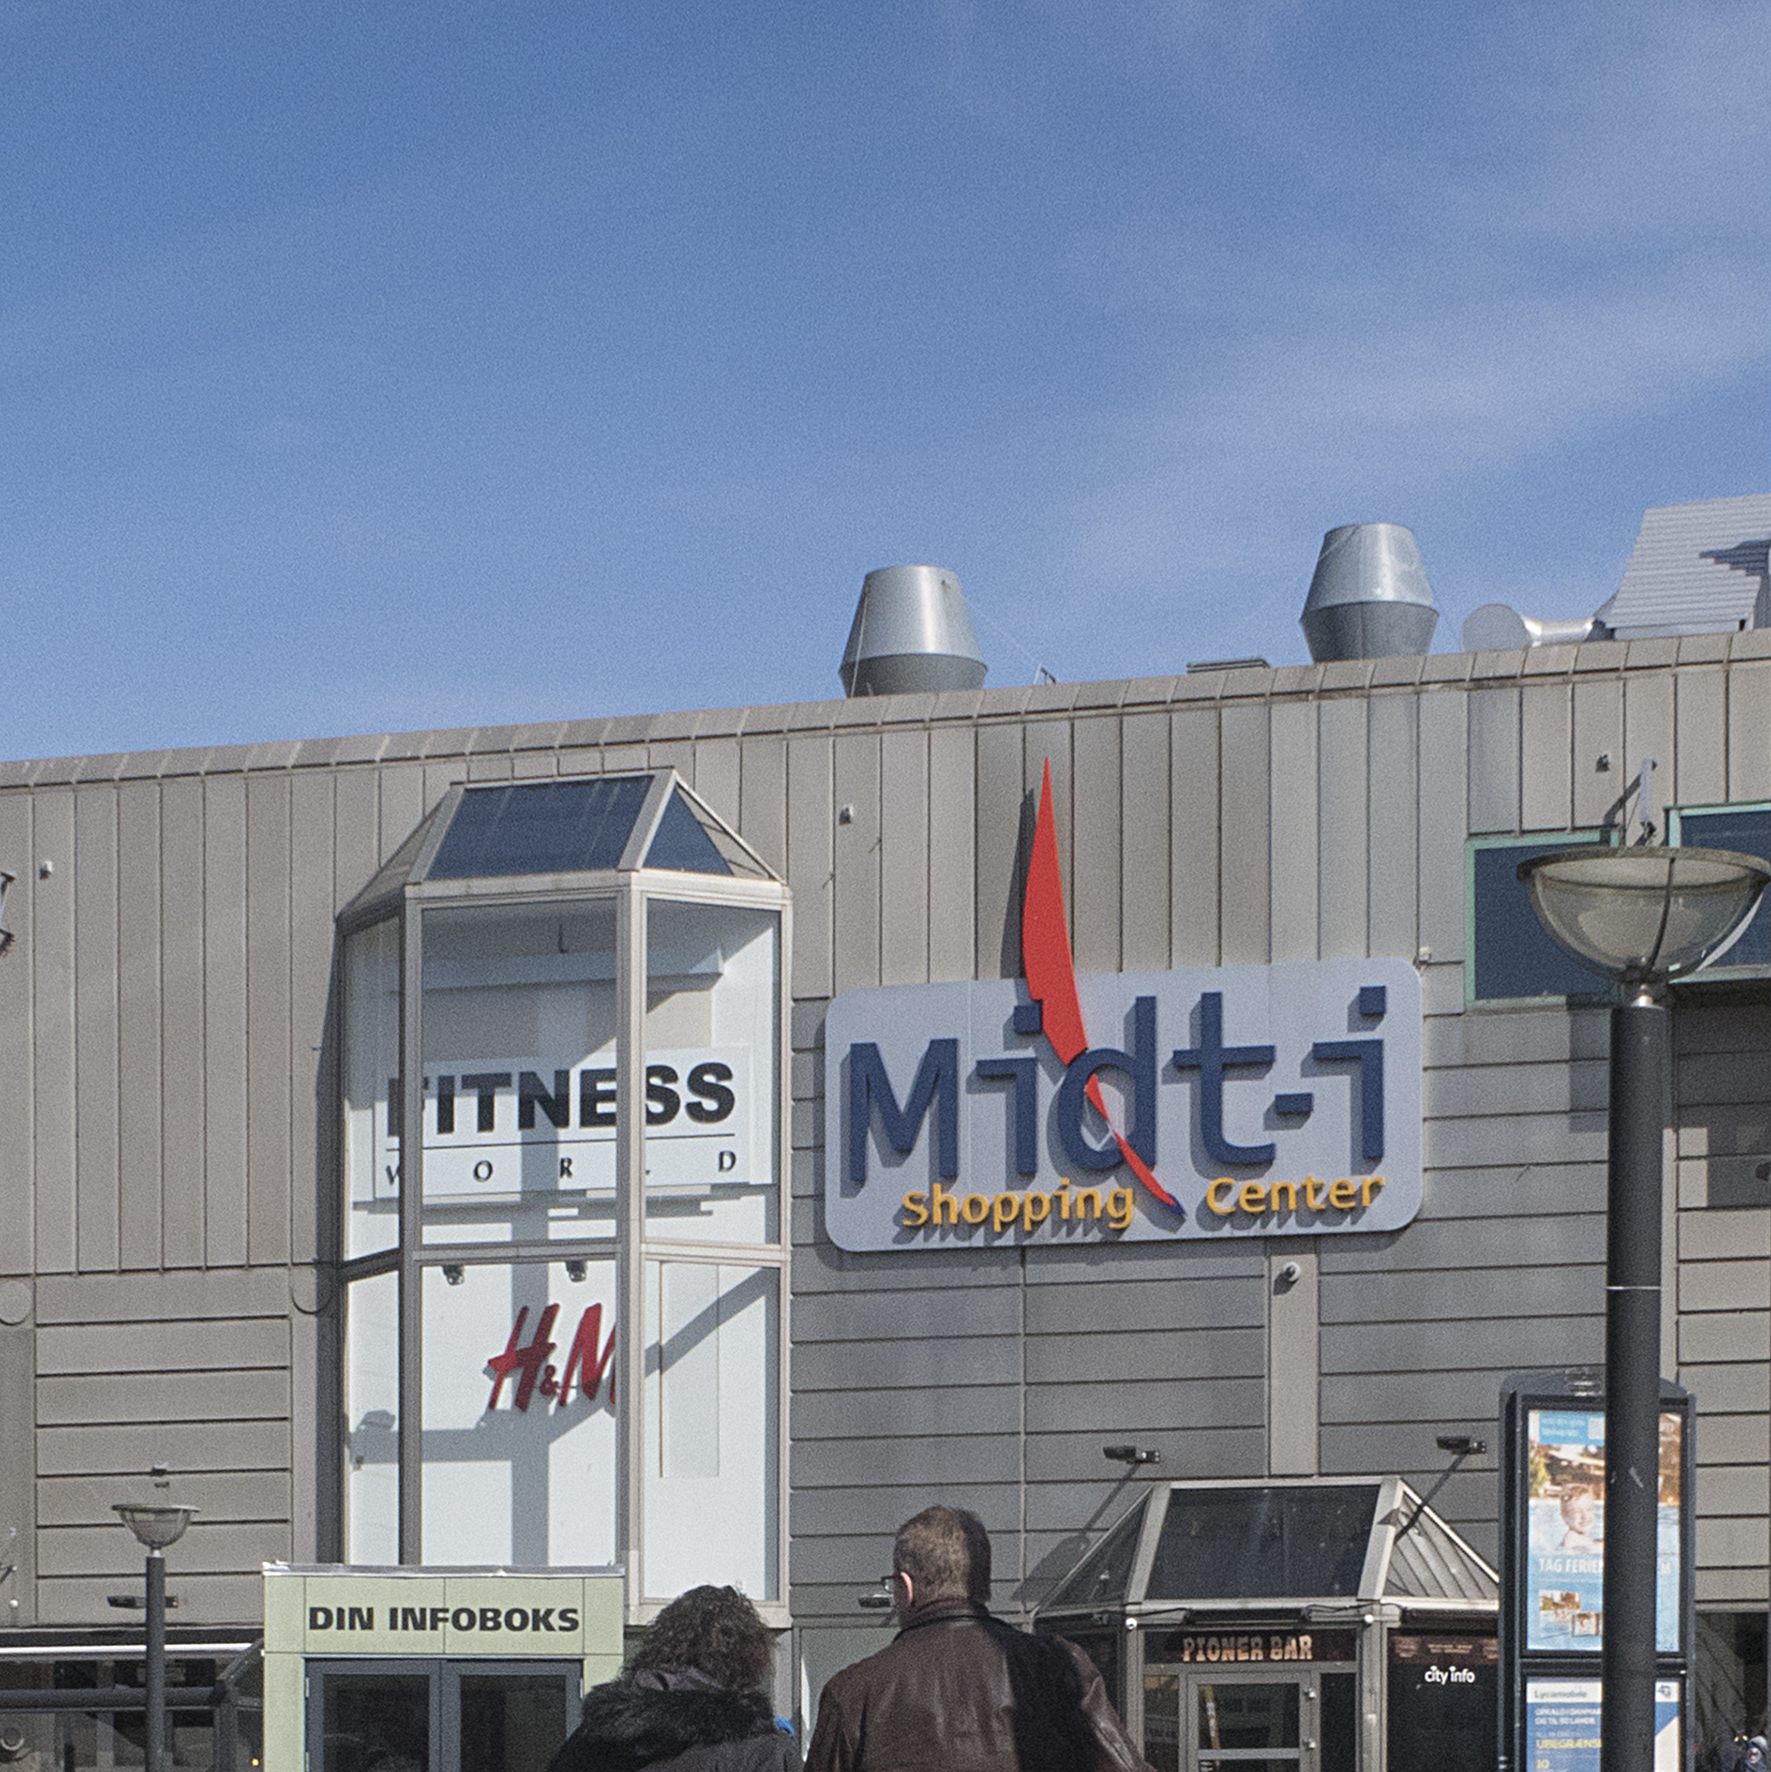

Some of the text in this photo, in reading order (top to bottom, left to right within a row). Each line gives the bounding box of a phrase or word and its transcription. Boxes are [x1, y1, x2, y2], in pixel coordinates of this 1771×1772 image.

[850, 985, 1386, 1182] Midt-i
[386, 1151, 736, 1185] ORD
[1205, 1174, 1386, 1214] Center
[488, 1302, 617, 1412] H&M
[1539, 1558, 1563, 1574] TAG
[309, 1606, 580, 1632] DIN INFOBOKS
[1182, 1634, 1314, 1662] PIONER BAR
[1424, 1665, 1476, 1685] city info
